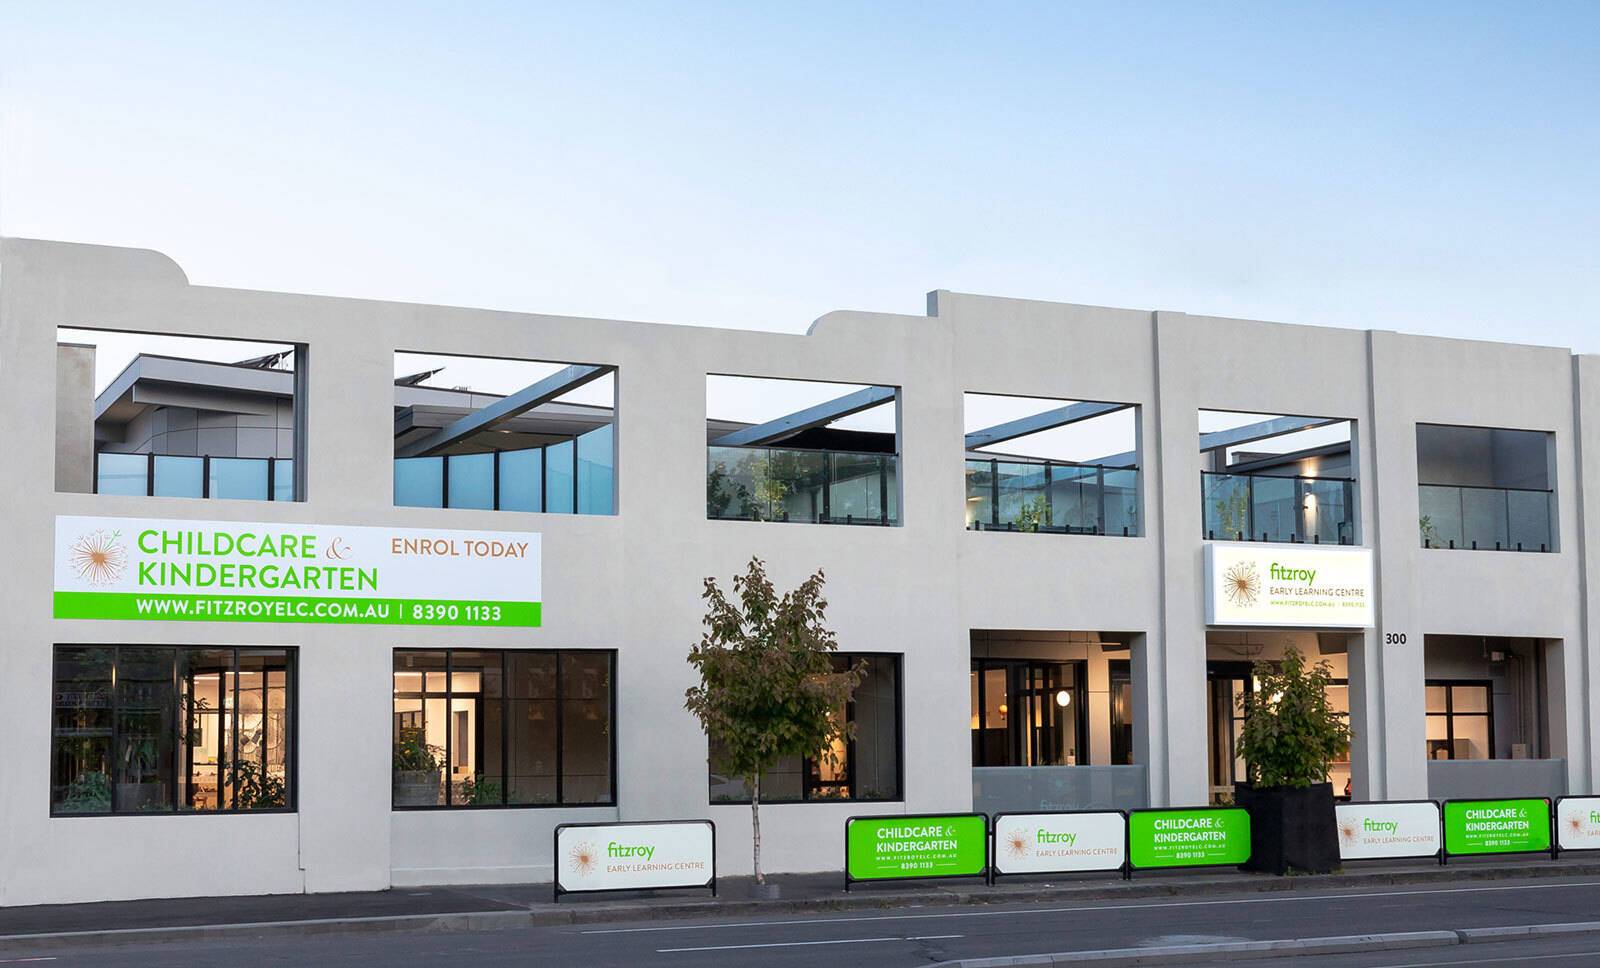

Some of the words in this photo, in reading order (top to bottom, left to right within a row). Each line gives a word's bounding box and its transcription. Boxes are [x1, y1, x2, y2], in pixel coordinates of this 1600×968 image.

[137, 530, 316, 559] CHILDCARE
[326, 538, 351, 560] &
[391, 538, 459, 557] ENROL
[464, 540, 529, 560] TODAY
[137, 562, 378, 591] KINDERGARTEN
[1269, 563, 1316, 585] fitzroy
[1269, 587, 1294, 596] EARLY
[1295, 588, 1334, 597] LEARNING
[1335, 588, 1365, 597] CENTRE
[136, 598, 390, 619] WWW.FITZROYELC.COM.AU
[412, 604, 457, 620] 8390
[464, 605, 502, 621] 1133
[1385, 632, 1407, 645] 300
[1465, 808, 1517, 820] CHILDCARE
[1154, 818, 1213, 831] CHILDCARE
[1214, 817, 1226, 829] &
[1364, 817, 1399, 835] fitzroy
[1465, 820, 1529, 832] KINDERGARTEN
[876, 825, 943, 839] CHILDCARE
[945, 825, 956, 837] &
[1036, 829, 1077, 848] fitzroy
[1154, 831, 1226, 844] KINDERGARTEN
[876, 839, 958, 853] KINDERGARTEN
[1364, 837, 1382, 845] EARLY
[1382, 836, 1411, 844] LEARNING
[1412, 835, 1434, 843] CENTRE
[607, 841, 655, 861] fitzroy
[1057, 848, 1091, 857] LEARNING
[1092, 847, 1118, 856] CENTRE
[607, 864, 632, 873] EARLY
[632, 862, 672, 872] LEARNING
[674, 860, 705, 870] CENTRE
